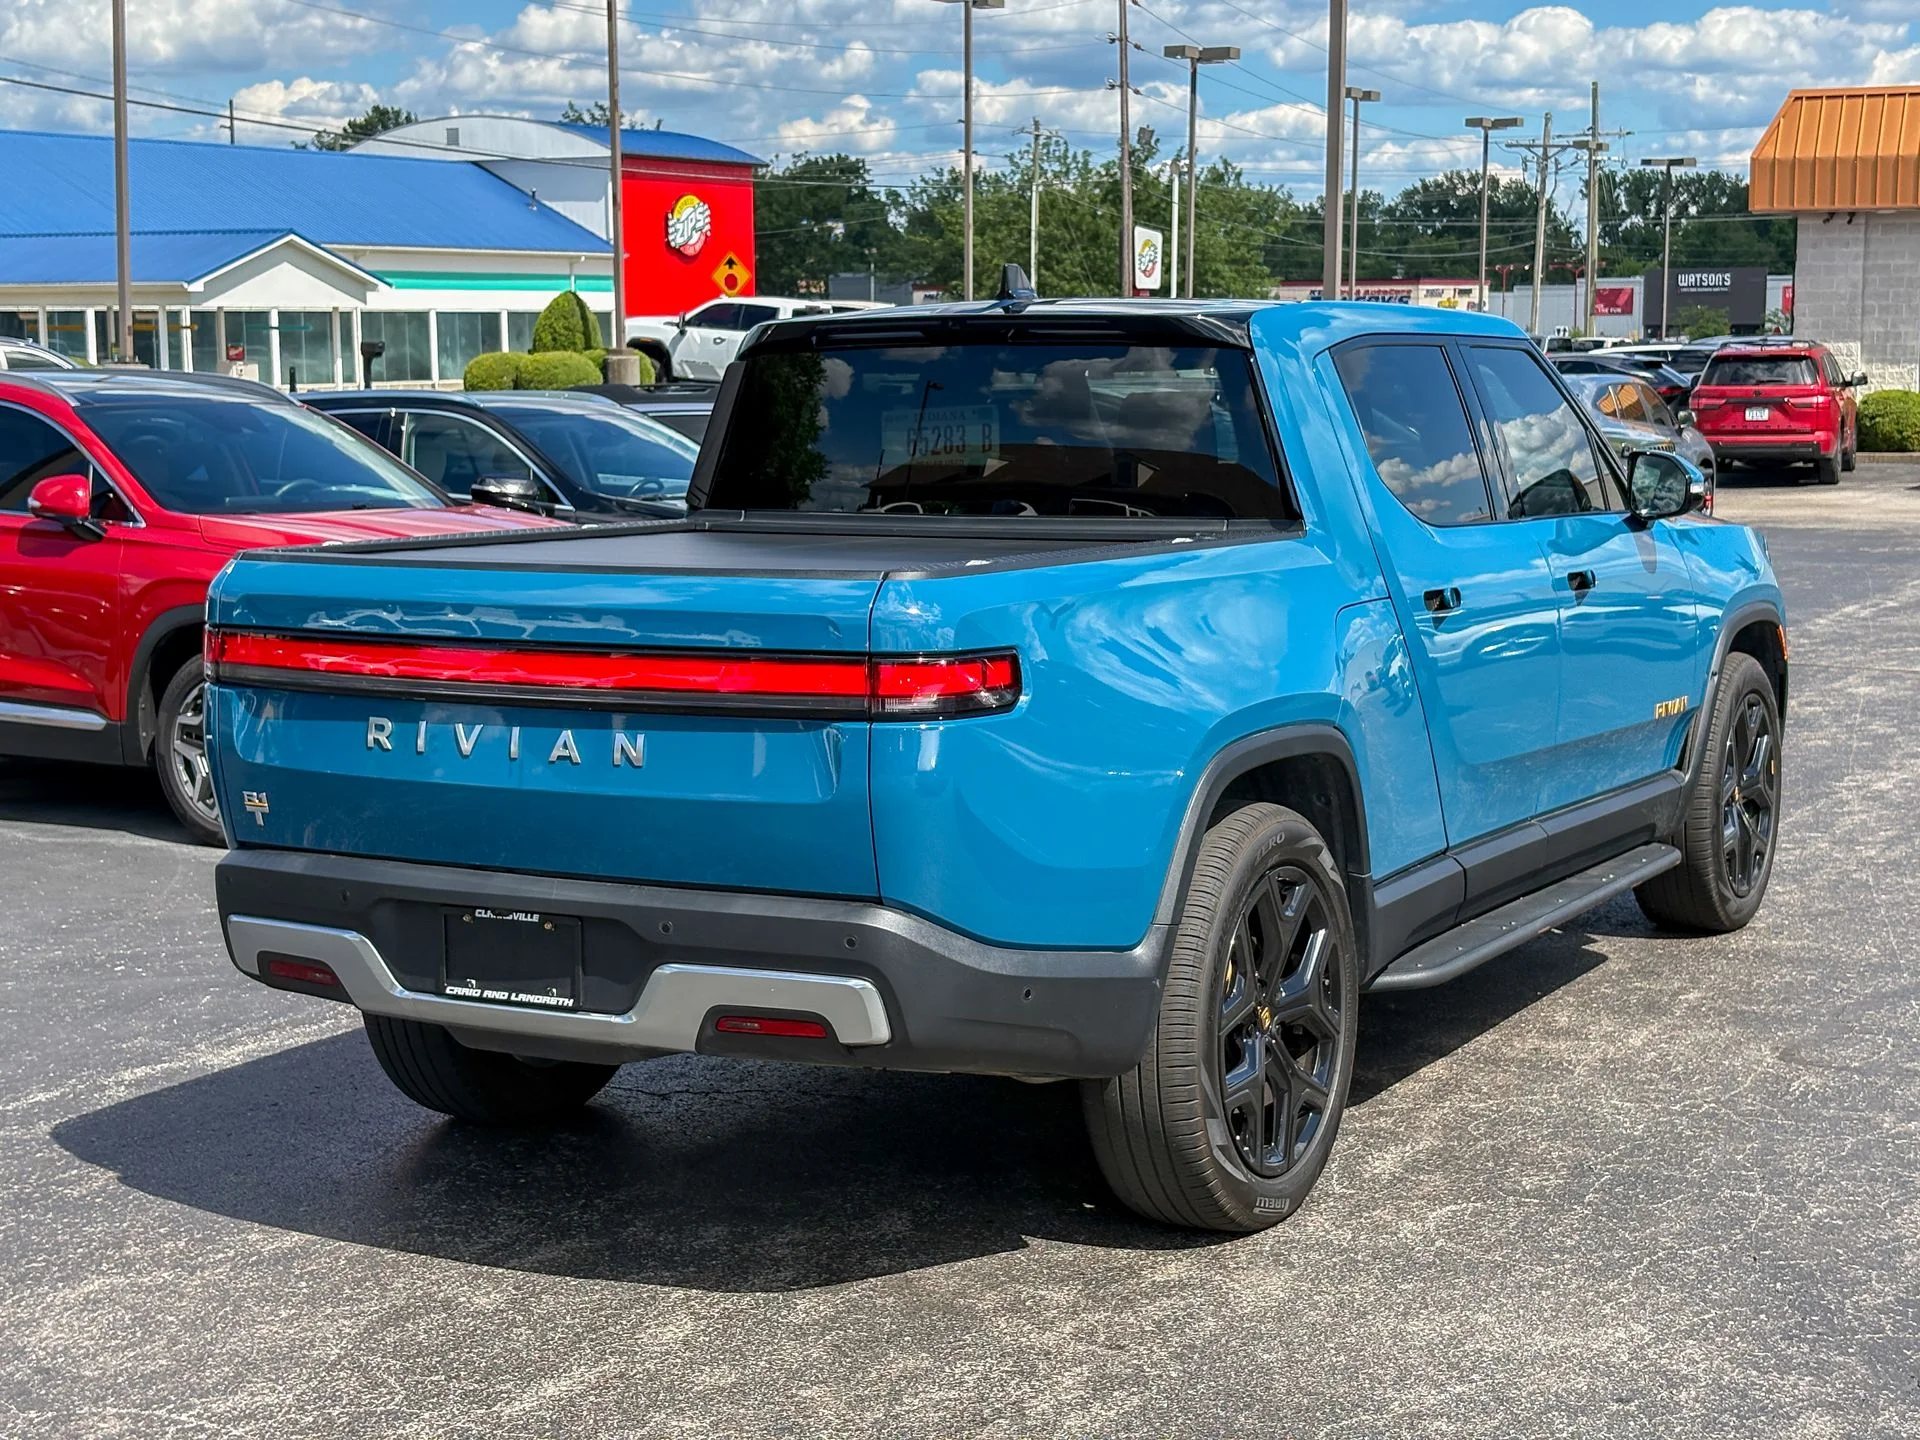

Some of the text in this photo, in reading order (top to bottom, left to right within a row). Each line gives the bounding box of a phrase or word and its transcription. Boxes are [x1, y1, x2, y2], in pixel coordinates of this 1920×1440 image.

[1678, 273, 1731, 287] WATSON'S
[907, 423, 993, 457] 65283 B
[366, 716, 646, 767] RIVIAN
[445, 986, 574, 1007] CRAIG AND LANDRETH
[1253, 1196, 1291, 1214] PIRELLI
